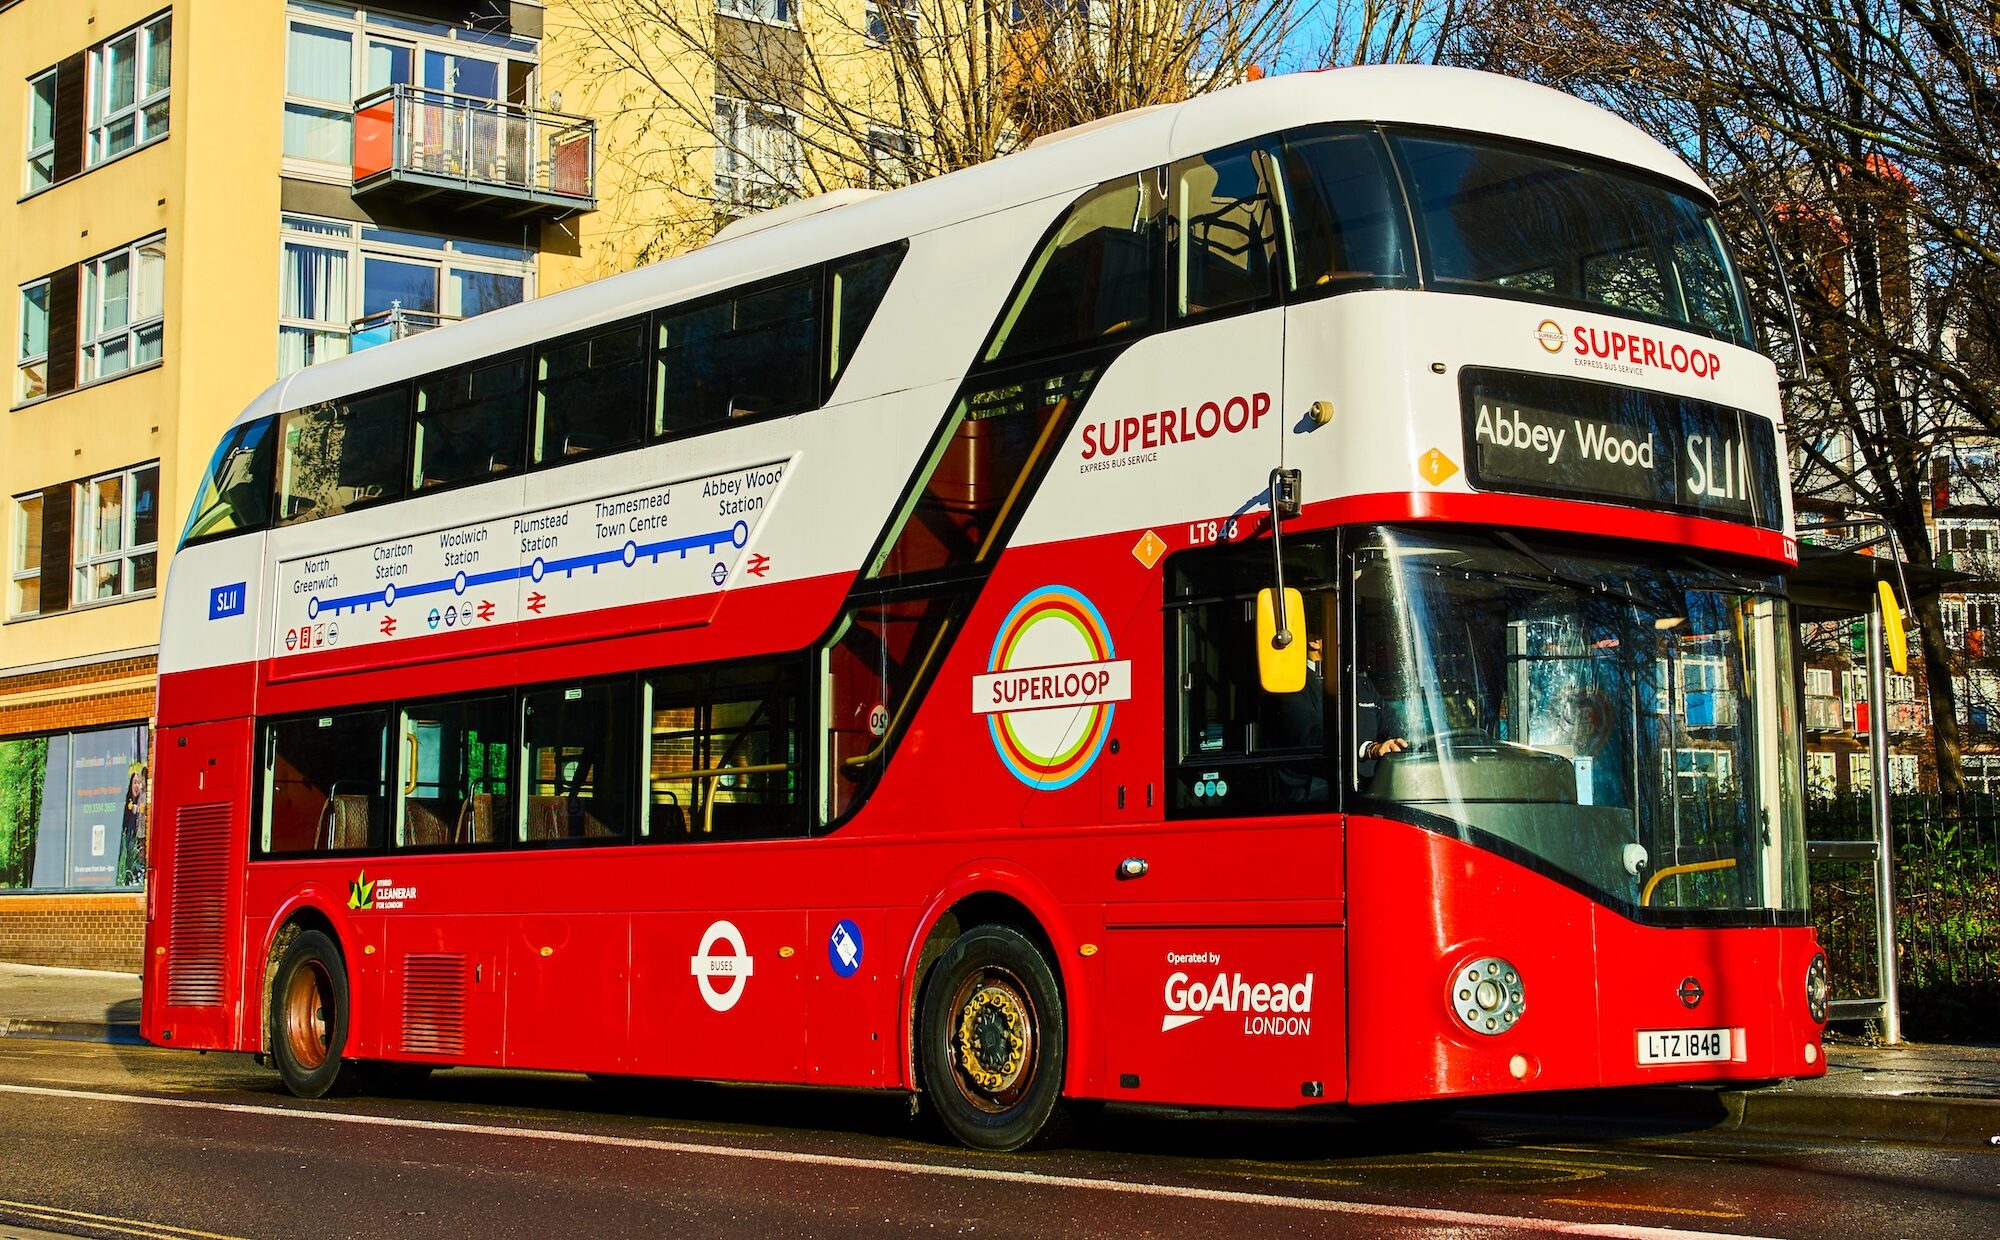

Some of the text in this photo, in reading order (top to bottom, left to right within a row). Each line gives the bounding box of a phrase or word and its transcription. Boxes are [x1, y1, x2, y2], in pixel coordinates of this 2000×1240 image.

[1573, 326, 1720, 380] SUPERLOOP
[1574, 358, 1643, 376] EXPRESS BUS SERVICE
[1081, 392, 1271, 460] SUPERLOOP
[1475, 404, 1653, 469] Abbey Wood
[1080, 452, 1157, 474] EXPRESS BUS SERVICE
[702, 467, 782, 498] Abbey Wood
[595, 490, 671, 518] Thamesmead
[719, 496, 763, 516] Station
[513, 511, 569, 535] Plumstead
[595, 514, 668, 539] Town Centre
[1189, 519, 1238, 544] LT848
[440, 527, 488, 548] Woolwich
[521, 535, 558, 553] Station
[373, 543, 413, 561] Charlton
[445, 550, 479, 567] Station
[304, 558, 330, 574] North
[375, 563, 408, 579] Station
[293, 574, 338, 594] Greenwich
[992, 670, 1110, 704] SUPERLOOP
[710, 960, 733, 971] BUSES
[1167, 952, 1220, 965] Operated by
[1164, 972, 1313, 1013] GoAhead
[1244, 1016, 1311, 1035] LONDON
[1648, 1033, 1720, 1058] LTZ 1848
